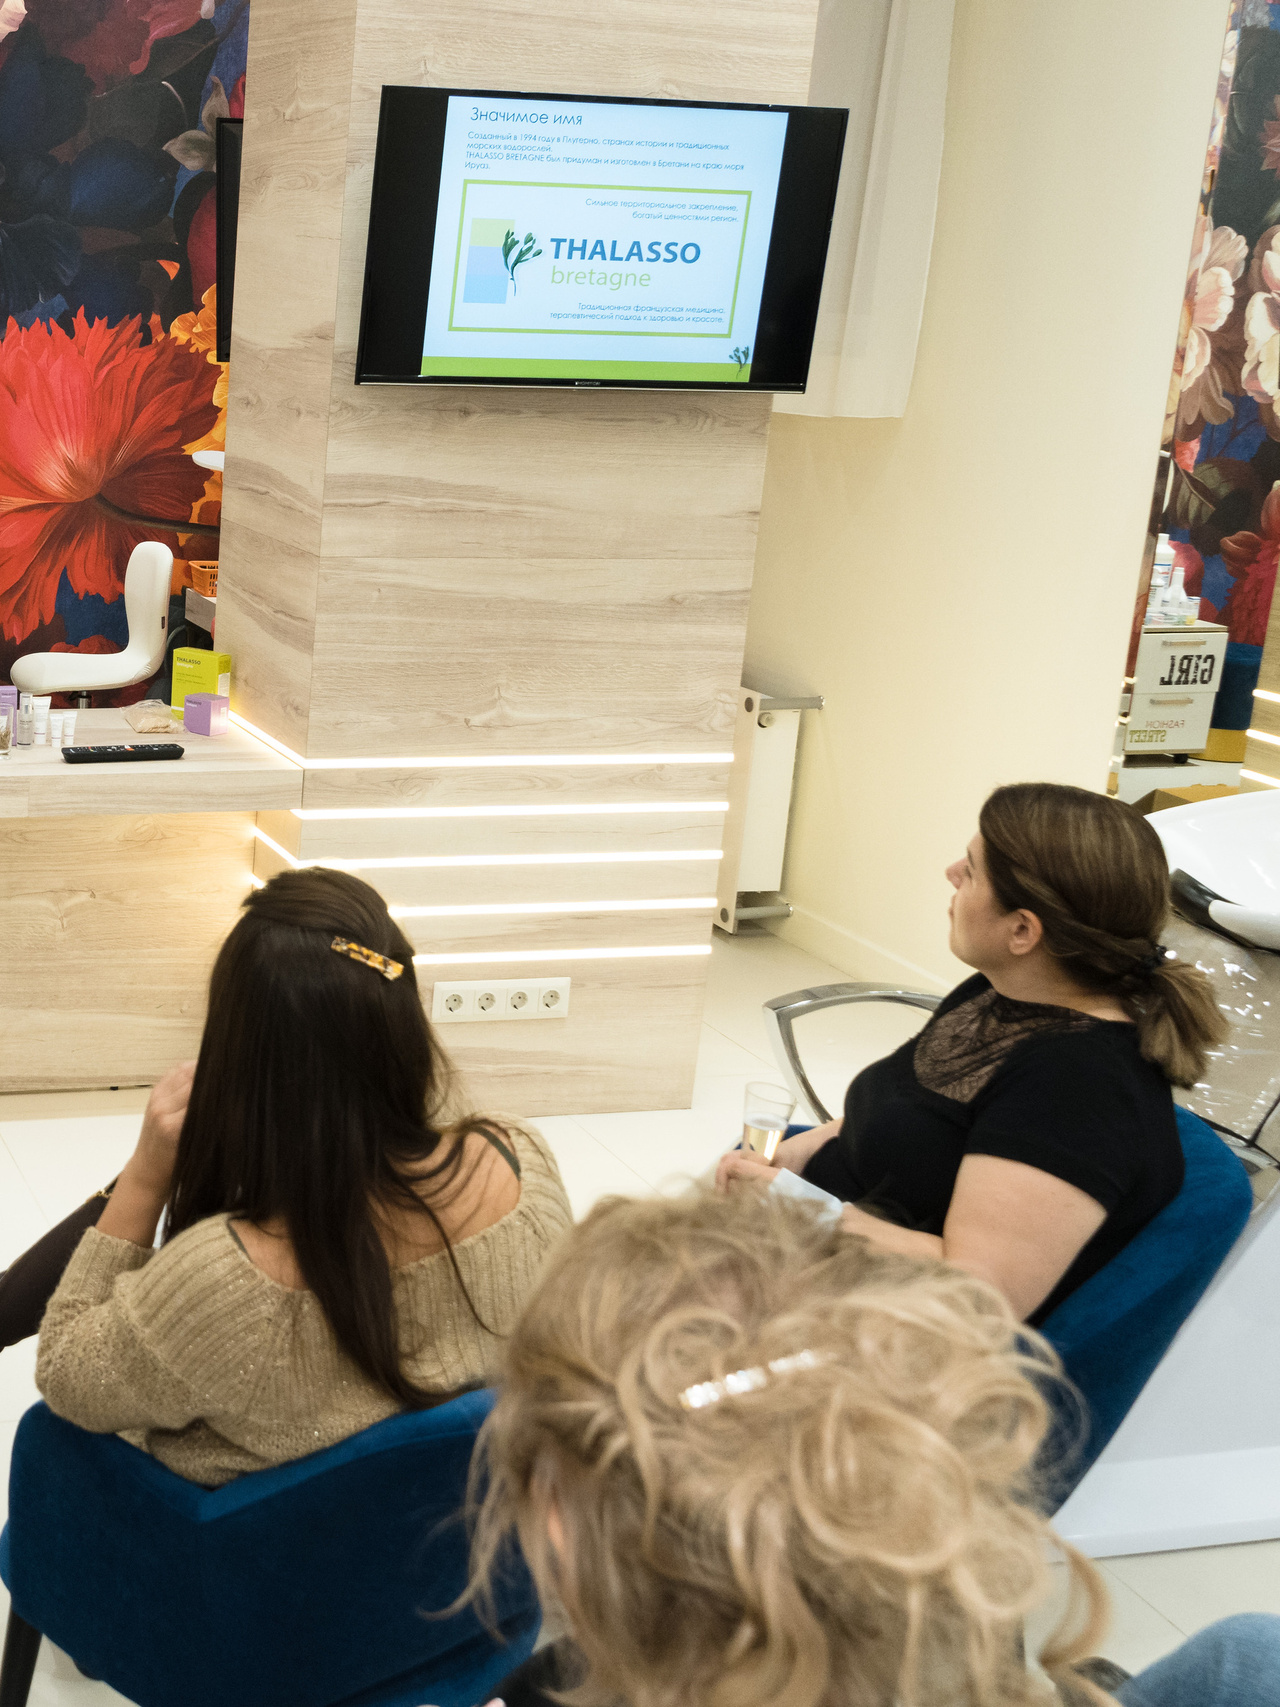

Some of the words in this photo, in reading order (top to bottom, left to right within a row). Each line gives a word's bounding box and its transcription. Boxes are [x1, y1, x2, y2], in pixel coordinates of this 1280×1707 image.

[470, 106, 548, 124] Значимое
[553, 114, 582, 125] имя
[467, 131, 512, 141] Созданный
[520, 133, 537, 142] 1994
[538, 135, 555, 144] году
[602, 138, 634, 147] странах
[635, 140, 667, 148] истории
[676, 142, 729, 150] традиционных
[503, 143, 553, 152] водорослей.
[466, 151, 504, 160] THALASSO
[505, 152, 544, 162] BRETAGNE
[546, 154, 560, 162] был
[562, 156, 602, 164] придуман
[610, 158, 651, 166] изготовлен
[658, 160, 690, 168] Бретани
[585, 198, 619, 207] Сильное
[620, 201, 687, 210] территориальное
[688, 203, 739, 212] закрепление,
[632, 210, 663, 219] богатый
[663, 213, 710, 222] ценностями
[550, 237, 701, 264] THALASSO
[550, 265, 651, 291] bretagne
[578, 302, 632, 312] Традиционная
[632, 304, 684, 313] французская
[550, 312, 614, 320] терапевтический
